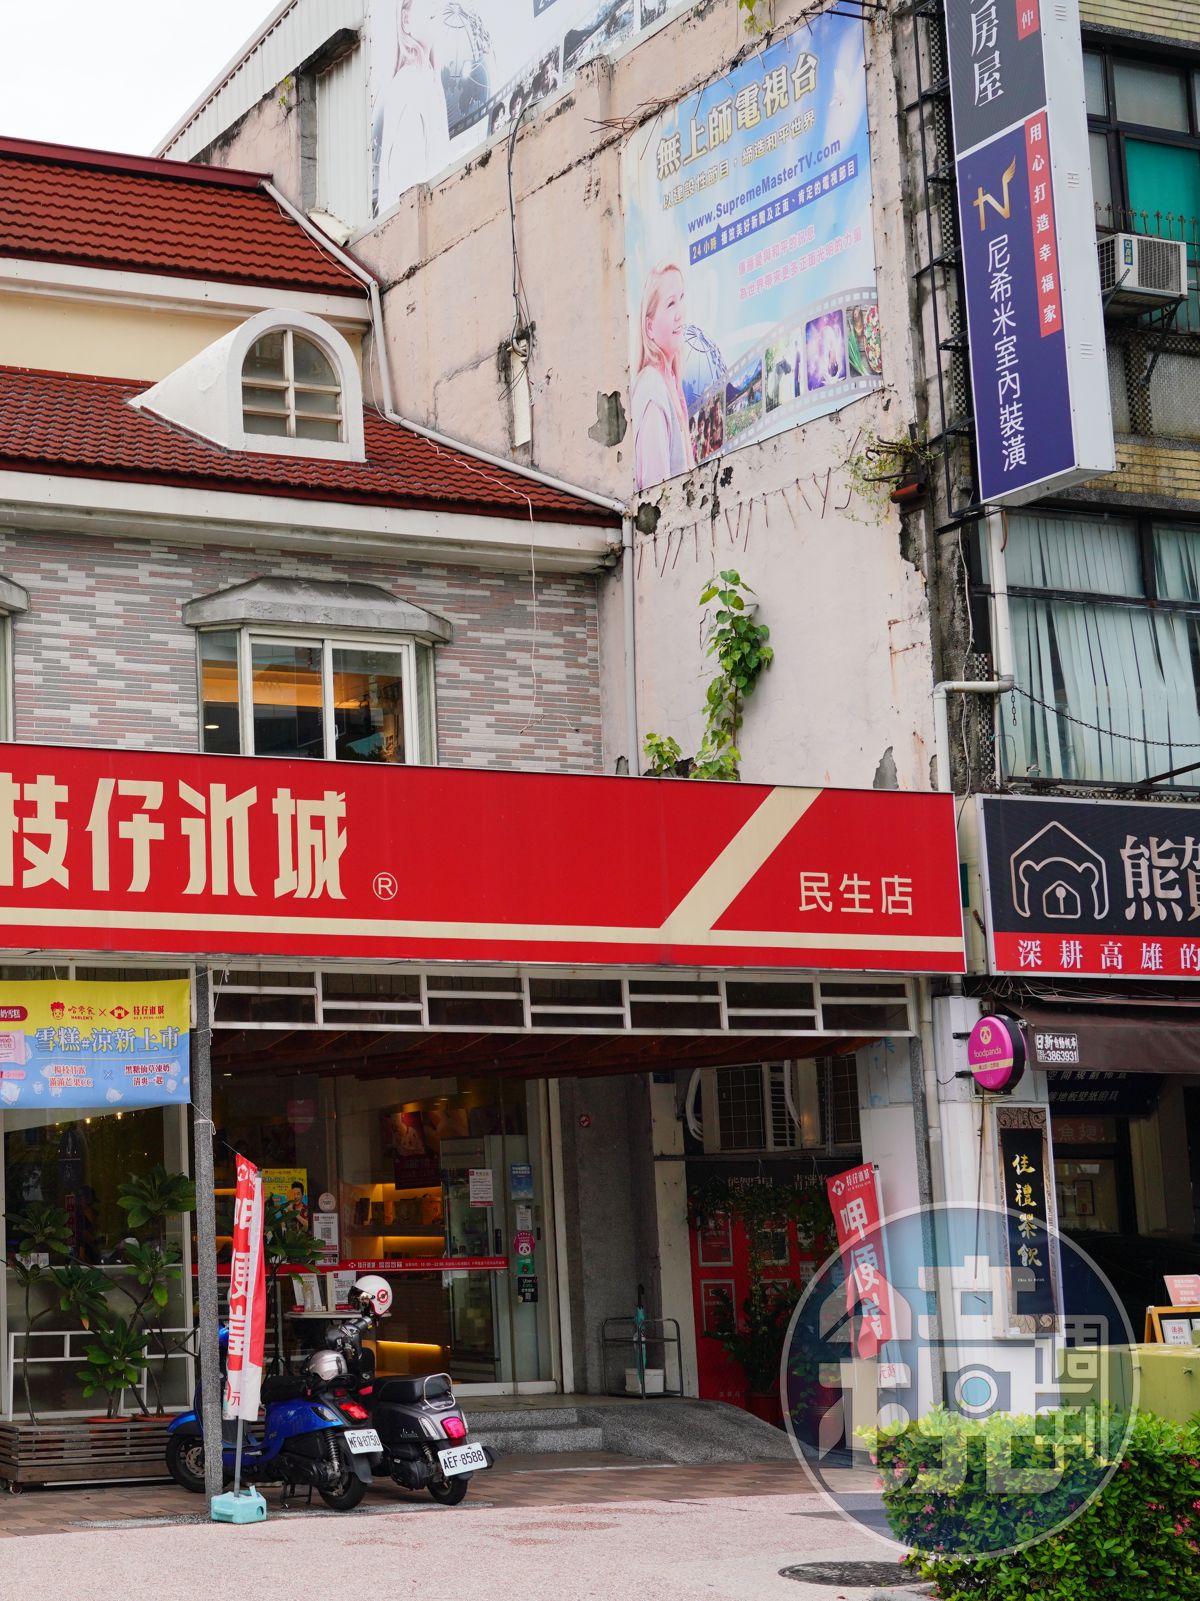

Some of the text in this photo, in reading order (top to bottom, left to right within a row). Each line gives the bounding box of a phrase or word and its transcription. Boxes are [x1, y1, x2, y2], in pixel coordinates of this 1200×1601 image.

[656, 52, 819, 181] 無上師電視台
[688, 139, 841, 233] www.SupremeMasterTV.com
[1029, 125, 1058, 324] 用心打造幸福家
[987, 234, 1027, 472] 尼希米室內裝潢
[799, 871, 912, 915] 民生店
[1018, 939, 1200, 971] 深耕高雄的
[974, 1047, 1001, 1059] foodpanda
[442, 1450, 485, 1470] AEF-8588
